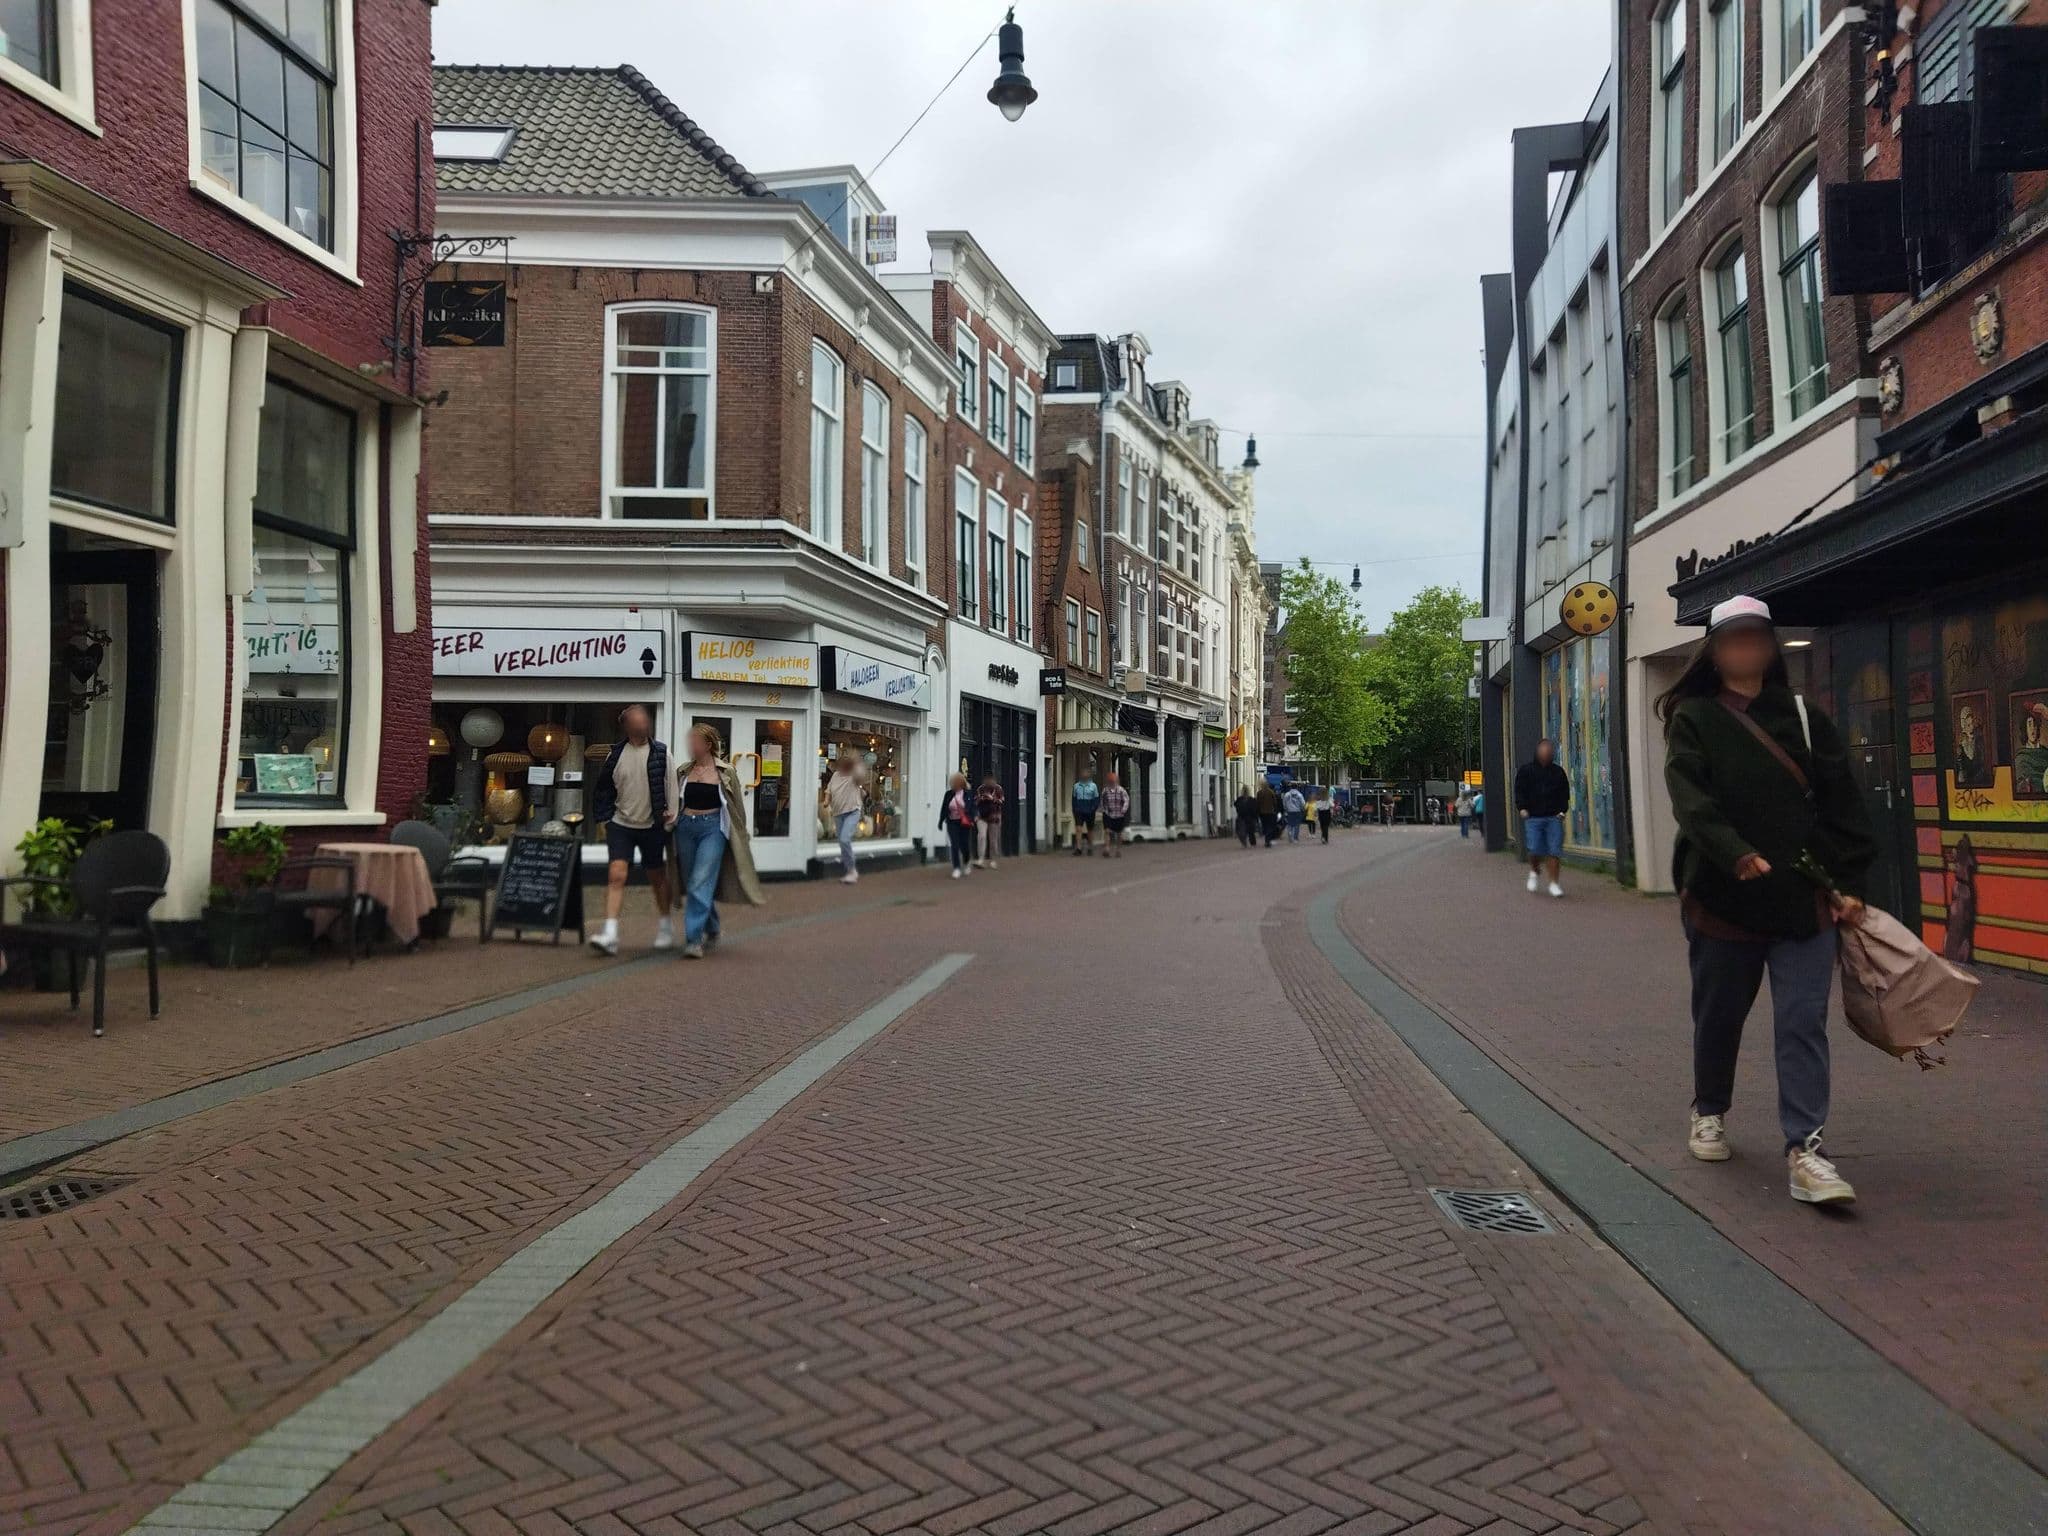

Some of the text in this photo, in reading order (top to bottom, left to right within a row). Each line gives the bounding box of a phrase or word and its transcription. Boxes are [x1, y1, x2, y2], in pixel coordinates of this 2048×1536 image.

[427, 309, 501, 322] klika
[493, 633, 627, 674] VERLICHTING
[698, 639, 755, 661] HELIOS
[748, 655, 810, 671] verlichting
[701, 669, 749, 682] HAARLEM
